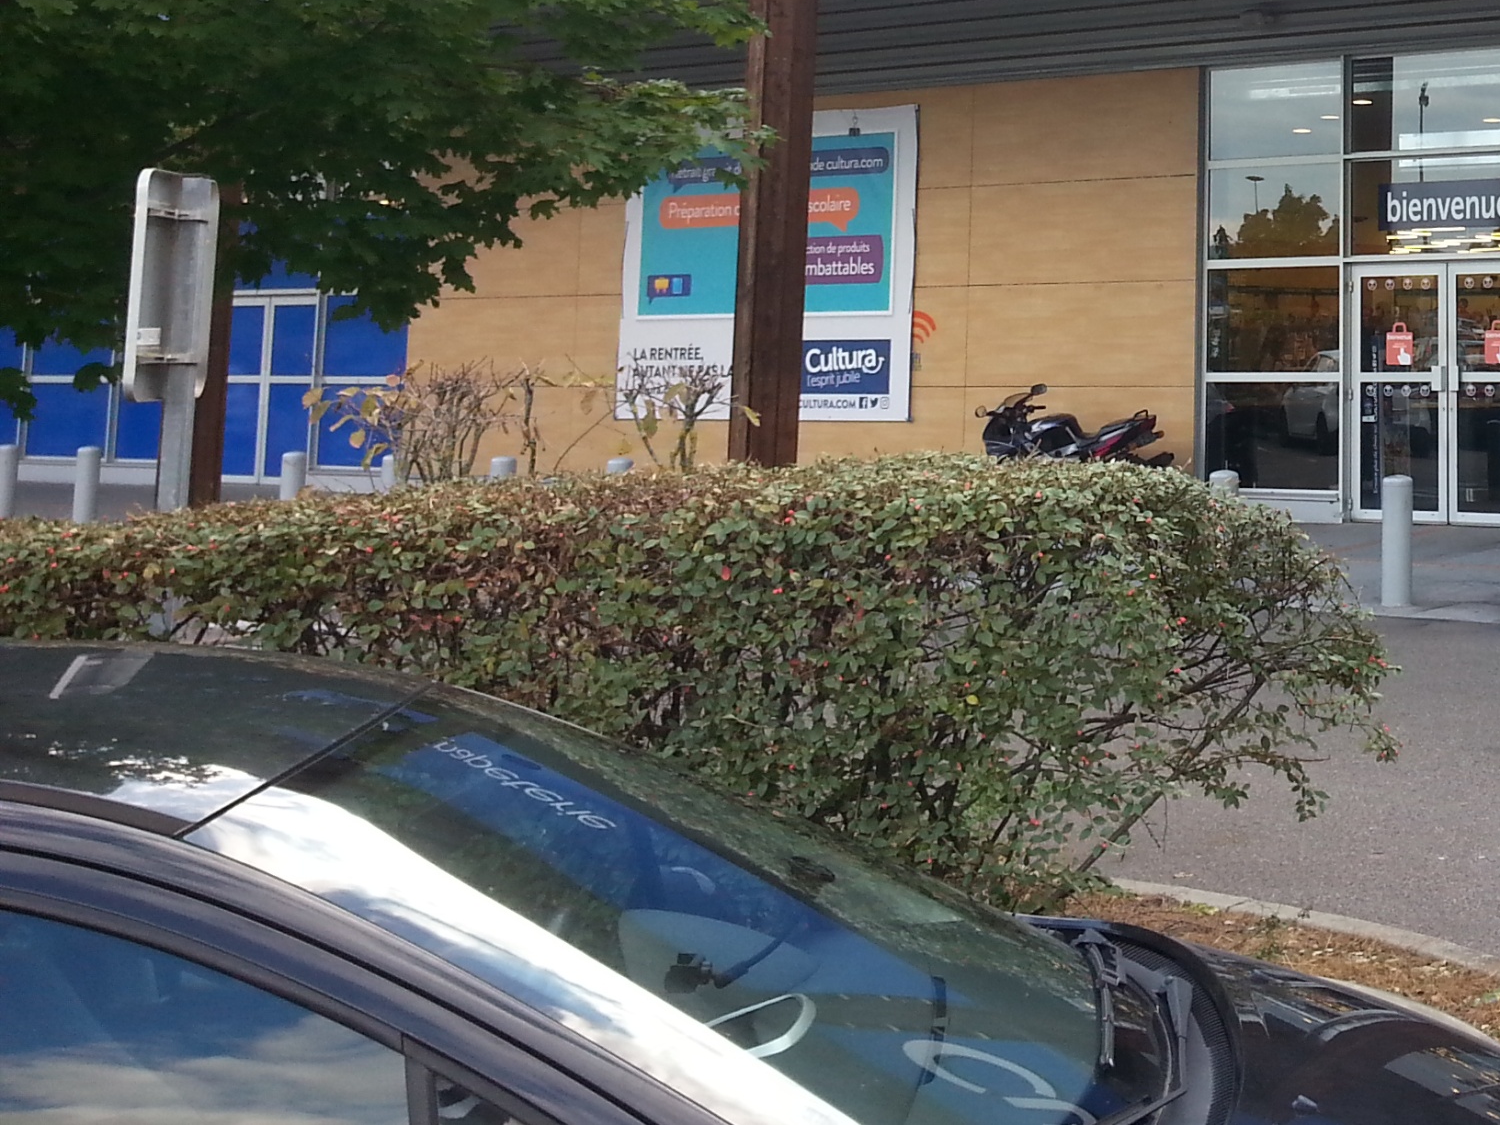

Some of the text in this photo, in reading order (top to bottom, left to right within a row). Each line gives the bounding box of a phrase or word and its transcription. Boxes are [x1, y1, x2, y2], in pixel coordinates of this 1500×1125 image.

[826, 156, 883, 171] cultura.com
[808, 195, 852, 212] scolaire
[668, 202, 732, 224] Préparation
[826, 242, 836, 254] de
[837, 241, 870, 256] produits
[805, 256, 875, 276] mbattables
[634, 343, 704, 362] LA RENTRÉE,
[805, 346, 880, 374] Cultura
[807, 372, 835, 388] l'esprit
